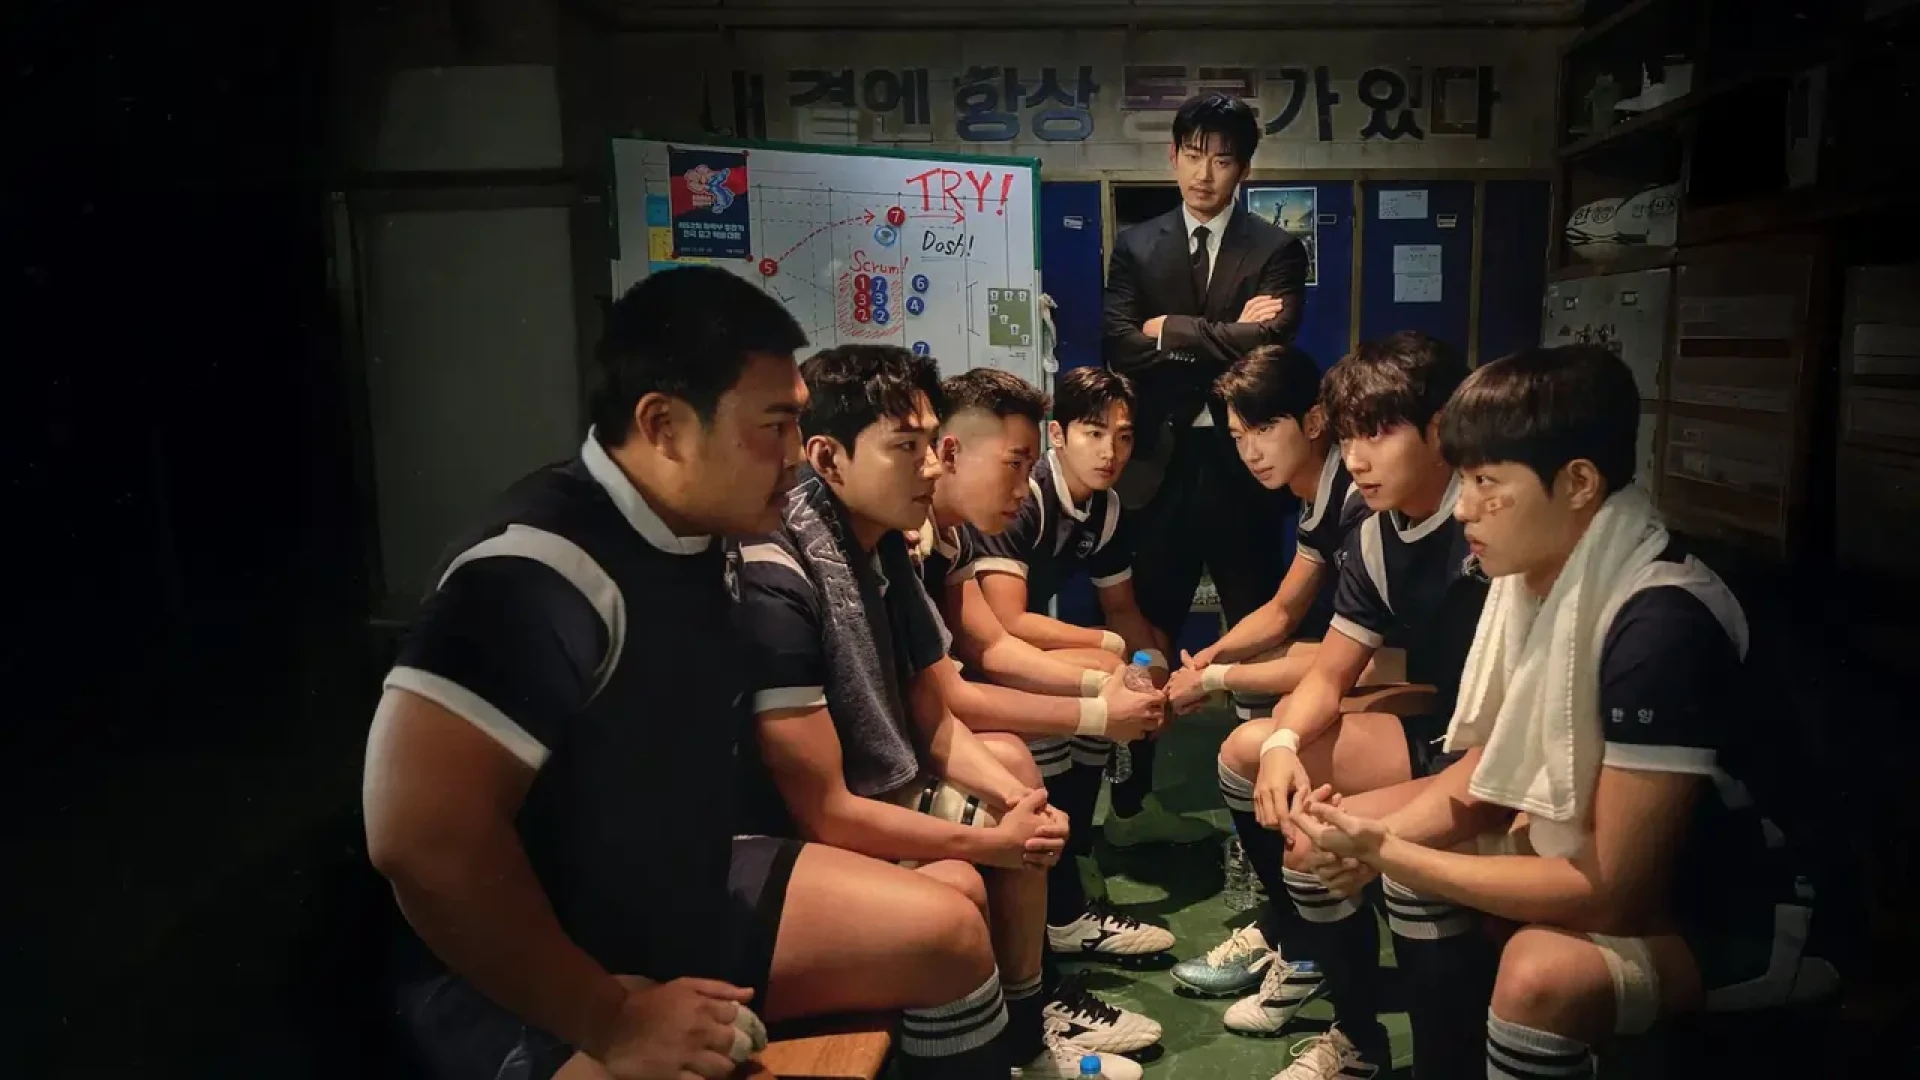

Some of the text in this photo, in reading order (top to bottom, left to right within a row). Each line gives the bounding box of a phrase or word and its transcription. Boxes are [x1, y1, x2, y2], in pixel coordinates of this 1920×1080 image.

[953, 65, 1100, 141] 항상
[1357, 65, 1501, 141] 있다
[905, 168, 1014, 216] TRY!
[850, 250, 909, 274] Scrum!
